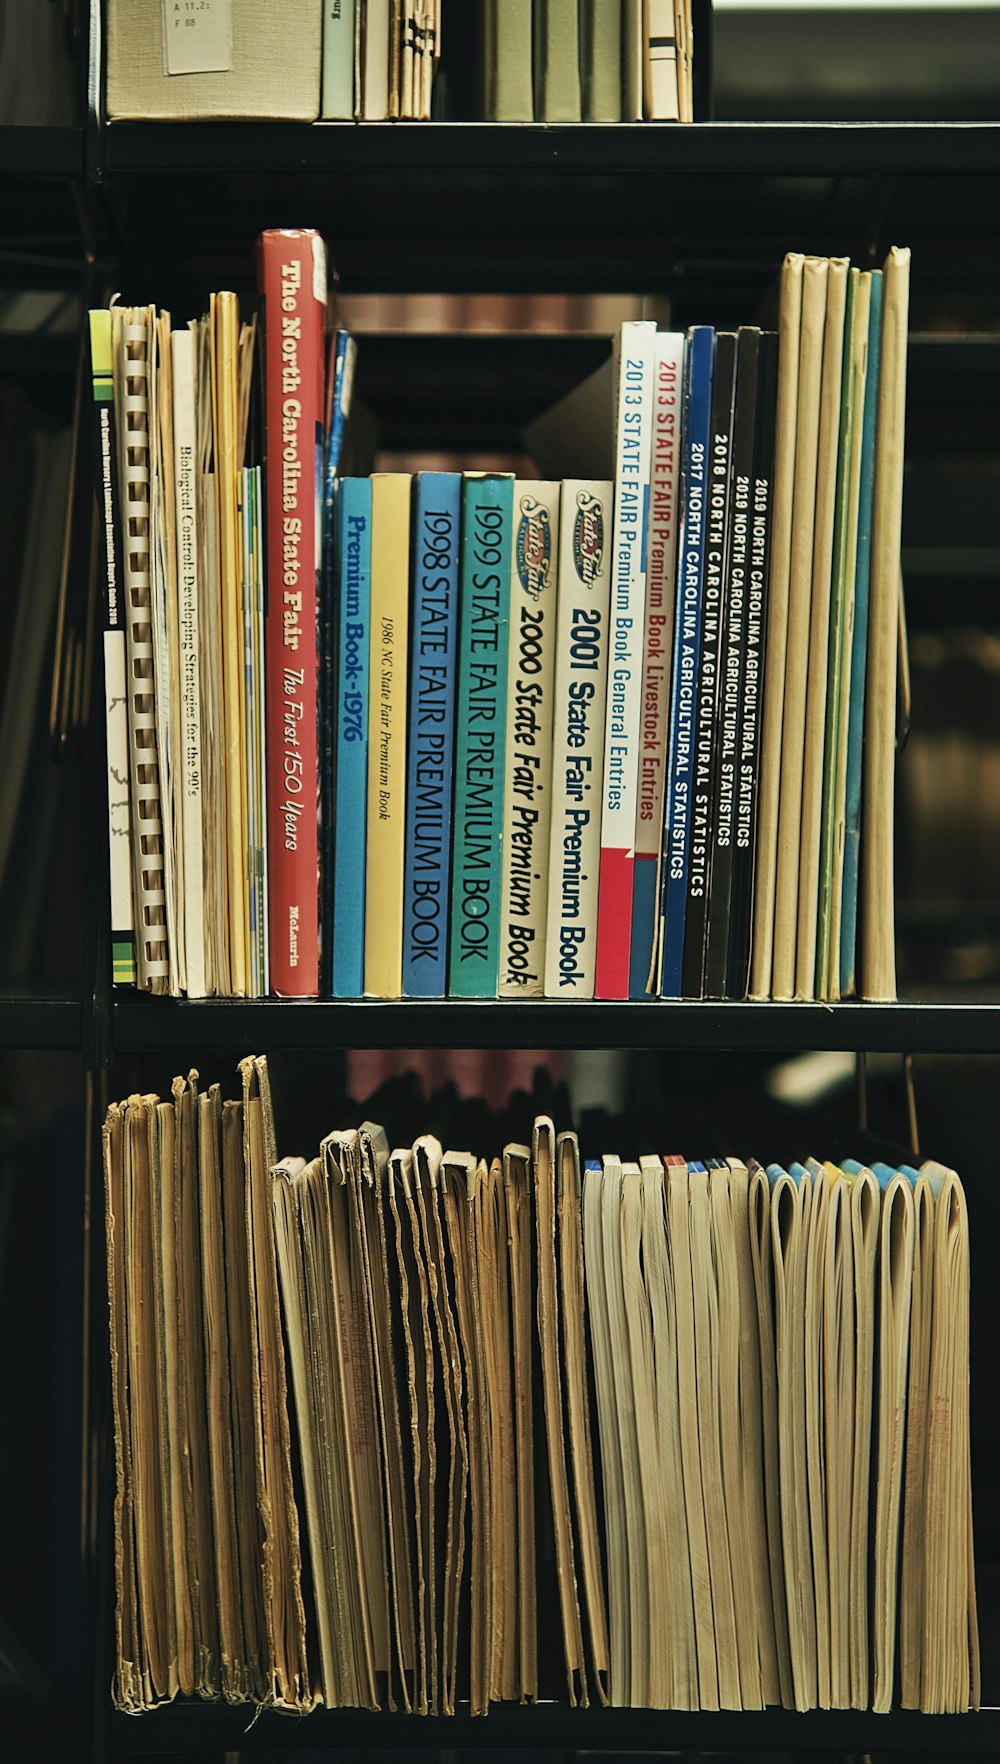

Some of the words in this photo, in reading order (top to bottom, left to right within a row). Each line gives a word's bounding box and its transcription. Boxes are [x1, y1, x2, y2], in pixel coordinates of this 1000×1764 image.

[174, 3, 181, 11] A
[175, 19, 181, 28] F
[282, 260, 301, 313] The
[282, 317, 302, 394] North
[626, 359, 643, 405] 2013
[658, 361, 677, 405] 2013
[101, 408, 109, 428] North
[102, 427, 111, 456] Carolina
[622, 412, 641, 473] STATE
[656, 413, 674, 473] STATE
[103, 456, 111, 482] Nursery
[178, 447, 193, 510] Biological
[282, 399, 302, 512] Carolina
[690, 443, 705, 480] 2017
[714, 434, 728, 476] 2018
[104, 488, 114, 523] Landscape
[576, 490, 604, 547] State
[620, 481, 639, 523] FAIR
[653, 480, 671, 522] FAIR
[687, 486, 703, 545] NORTH
[709, 484, 726, 543] NORTH
[736, 476, 750, 508] 2019
[754, 479, 769, 511] 2019
[106, 524, 115, 562] Association
[182, 515, 194, 571] Control:
[283, 517, 303, 586] State
[422, 509, 454, 570] 1998
[473, 503, 504, 567] 1999
[520, 495, 551, 556] State
[733, 513, 748, 563] NORTH
[751, 516, 766, 565] NORTH
[346, 515, 366, 618] Premium
[524, 552, 552, 602] Fair
[580, 543, 604, 590] Fair
[616, 531, 638, 610] Premium
[650, 529, 670, 607] Premium
[683, 551, 700, 639] CAROLINA
[704, 551, 721, 641] CAROLINA
[109, 588, 117, 607] Guide
[182, 576, 197, 650] Developing
[283, 591, 303, 651] Fair
[420, 576, 451, 656] STATE
[470, 573, 501, 655] STATE
[729, 569, 745, 642] CAROLINA
[747, 571, 764, 645] CAROLINA
[380, 616, 394, 645] 1986
[381, 649, 393, 667] NC
[518, 606, 545, 674] 2000
[570, 608, 602, 670] 2001
[613, 617, 633, 662] Book
[647, 614, 667, 658] Book
[183, 655, 197, 718] Strategies
[284, 667, 305, 695] The
[380, 669, 393, 700] State
[417, 666, 447, 726] FAIR
[467, 662, 498, 724] FAIR
[611, 669, 632, 738] General
[643, 665, 665, 751] Livestock
[676, 645, 694, 776] AGRICULTURAL
[722, 647, 741, 758] AGRICULTURAL
[741, 649, 759, 760] AGRICULTURAL
[187, 724, 198, 742] for
[284, 702, 304, 747] First
[380, 703, 393, 728] Fair
[514, 680, 544, 745] State
[567, 682, 596, 747] State
[696, 651, 715, 786] AGRICULTURAL
[187, 747, 199, 767] the
[188, 772, 199, 797] 90's
[284, 750, 304, 794] 150
[379, 730, 393, 785] Premium
[512, 753, 544, 800] Fair
[566, 756, 591, 802] Fair
[608, 746, 627, 810] Entries
[379, 789, 391, 821] Book
[414, 733, 445, 872] PREMIUM
[463, 731, 495, 870] PREMIUM
[640, 756, 661, 820] Entries
[718, 764, 734, 847] STATISTICS
[737, 765, 754, 848] STATISTICS
[280, 800, 305, 852] Years
[671, 782, 688, 879] STATISTICS
[691, 795, 708, 897] STATISTICS
[510, 805, 541, 917] Premium
[562, 809, 589, 919] Premium
[289, 906, 300, 967] McLaurin
[410, 879, 440, 964] BOOK
[460, 878, 491, 963] BOOK
[507, 924, 538, 985] Book
[559, 926, 586, 987] Book
